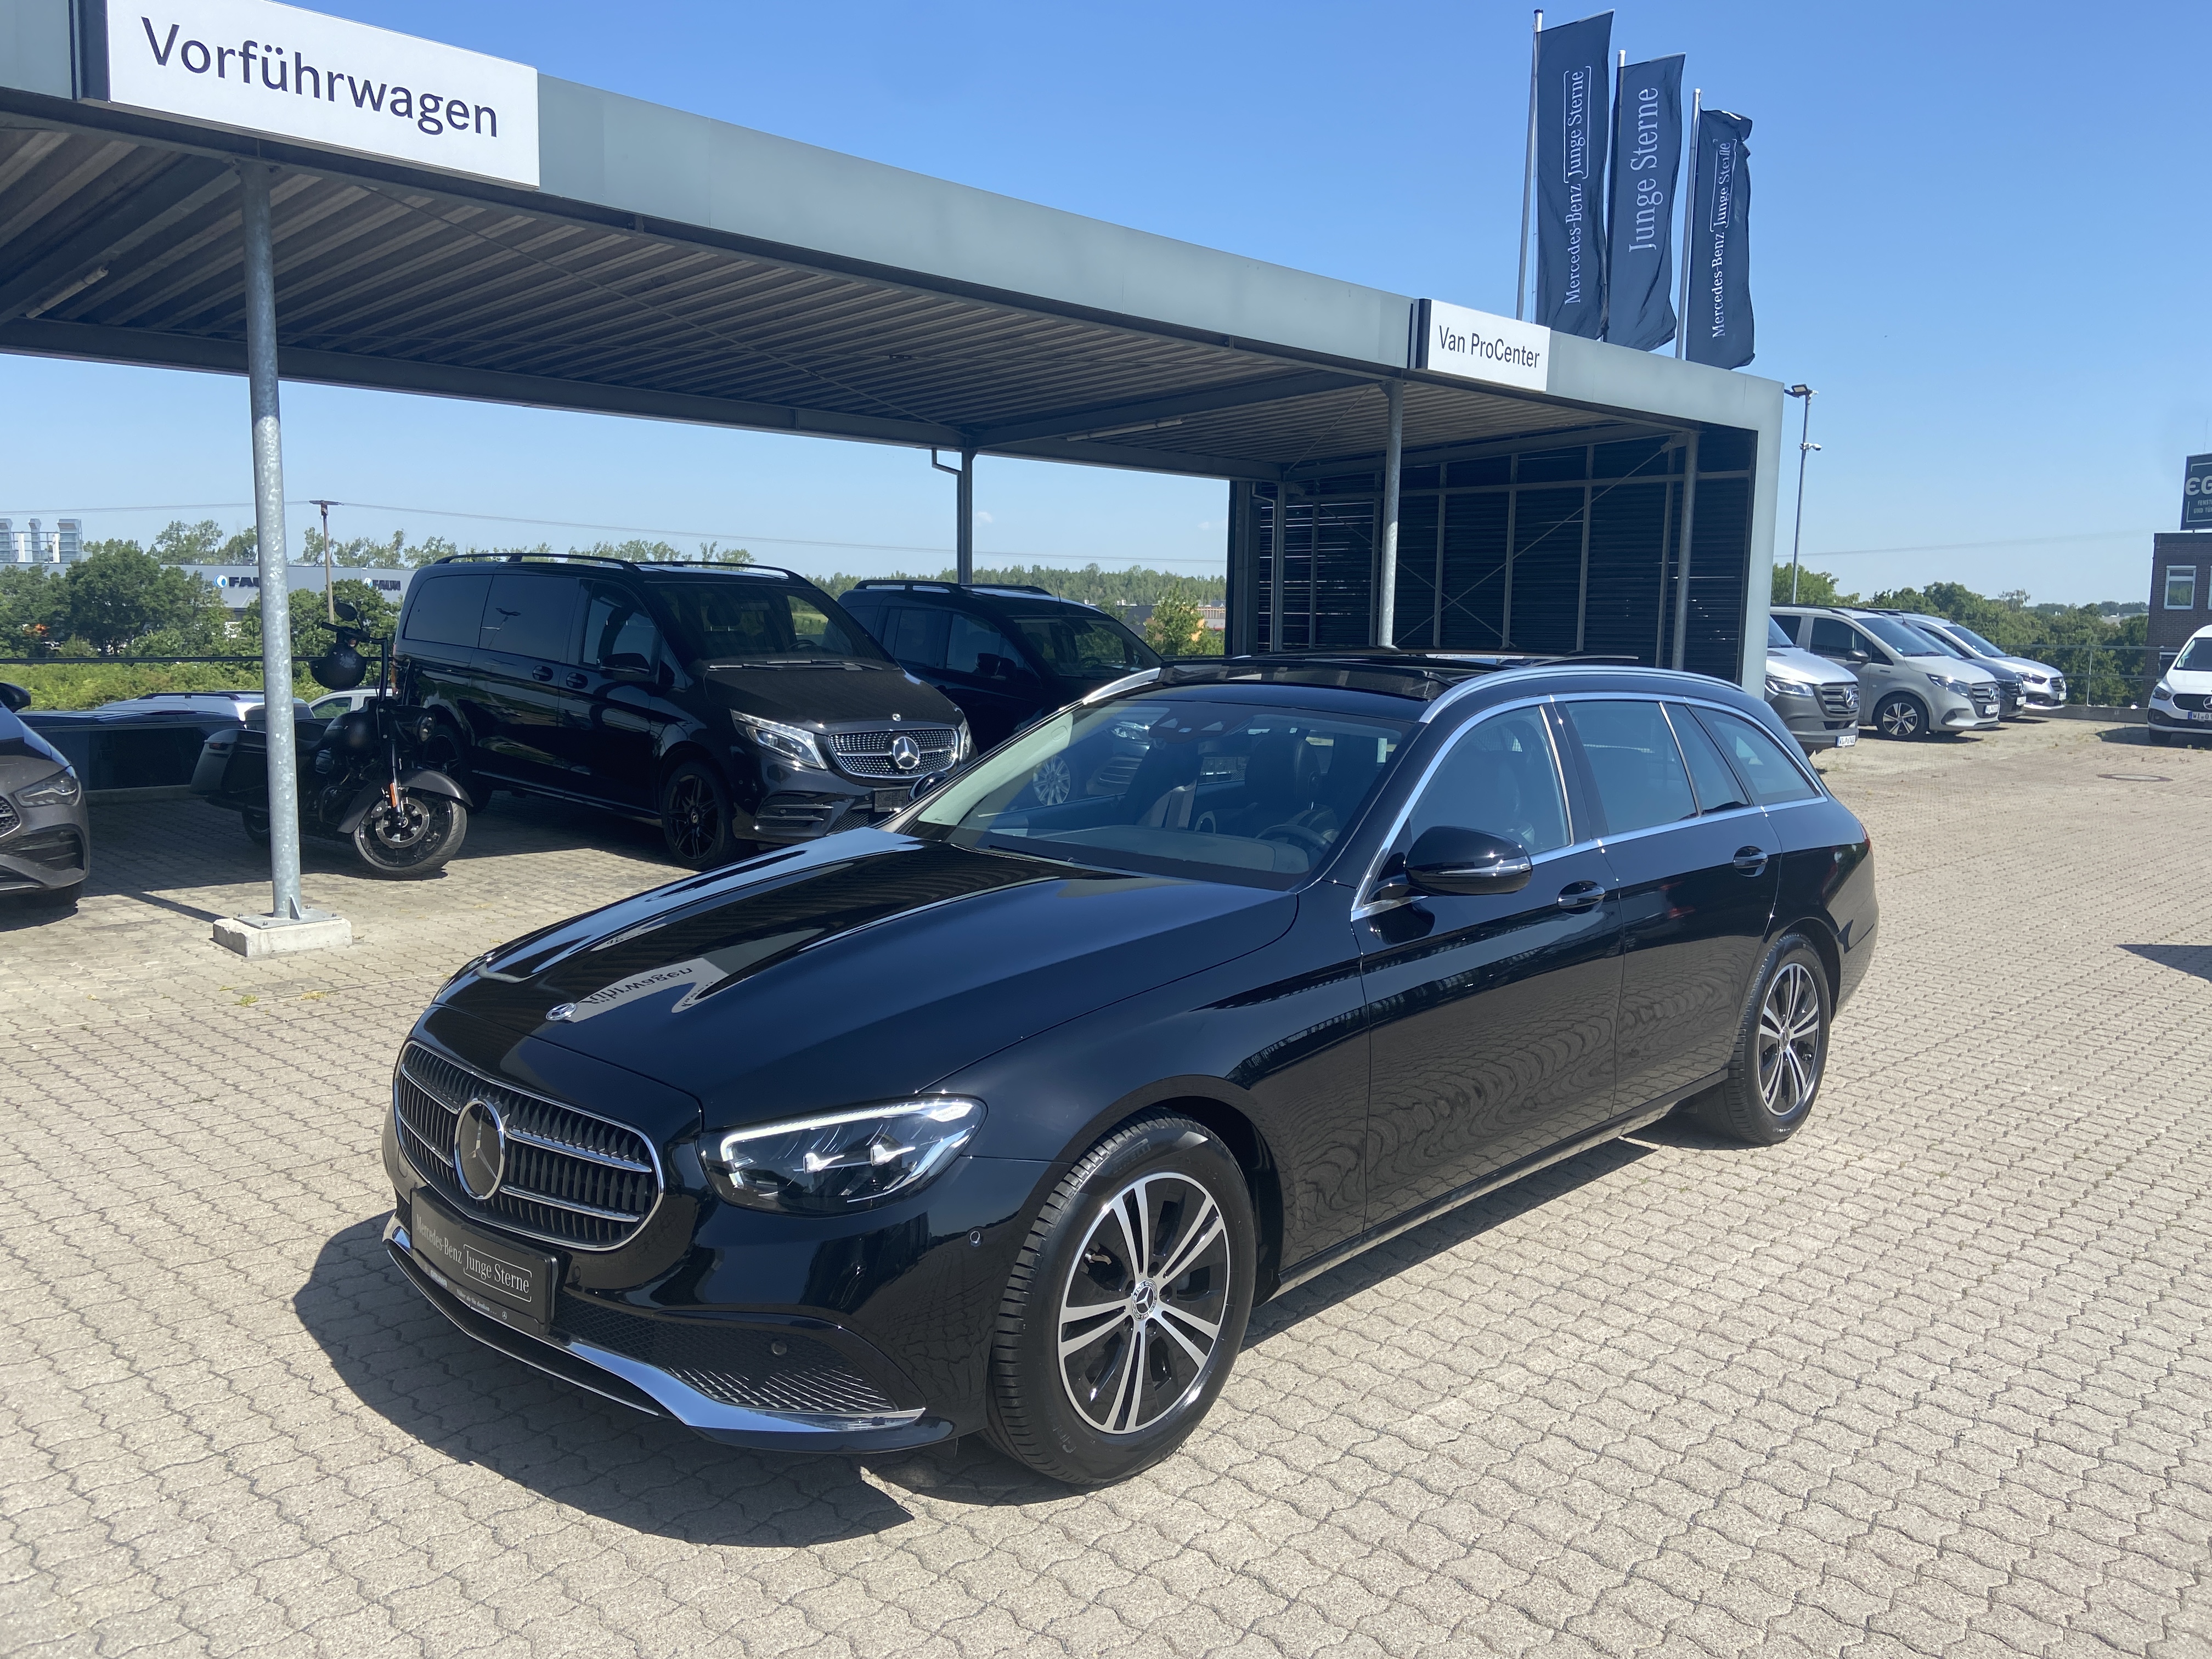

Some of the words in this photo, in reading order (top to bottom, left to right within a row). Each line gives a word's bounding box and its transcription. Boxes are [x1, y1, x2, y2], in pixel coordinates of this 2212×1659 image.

[141, 16, 498, 138] Vorführwagen
[1567, 70, 1585, 126] Sterne
[1567, 129, 1586, 178] Junge
[1630, 87, 1658, 171] Sterne
[1564, 183, 1583, 305] Mercedes-Benz
[1628, 178, 1663, 253] Junge
[1713, 187, 1731, 226] Junge
[1712, 232, 1726, 338] Mercedes-Benz
[1439, 325, 1465, 353] Van
[1471, 332, 1540, 368] ProCenter
[416, 1214, 462, 1265] Mercedes-Benz
[465, 1250, 492, 1279] Junge
[494, 1263, 530, 1294] Sterne
